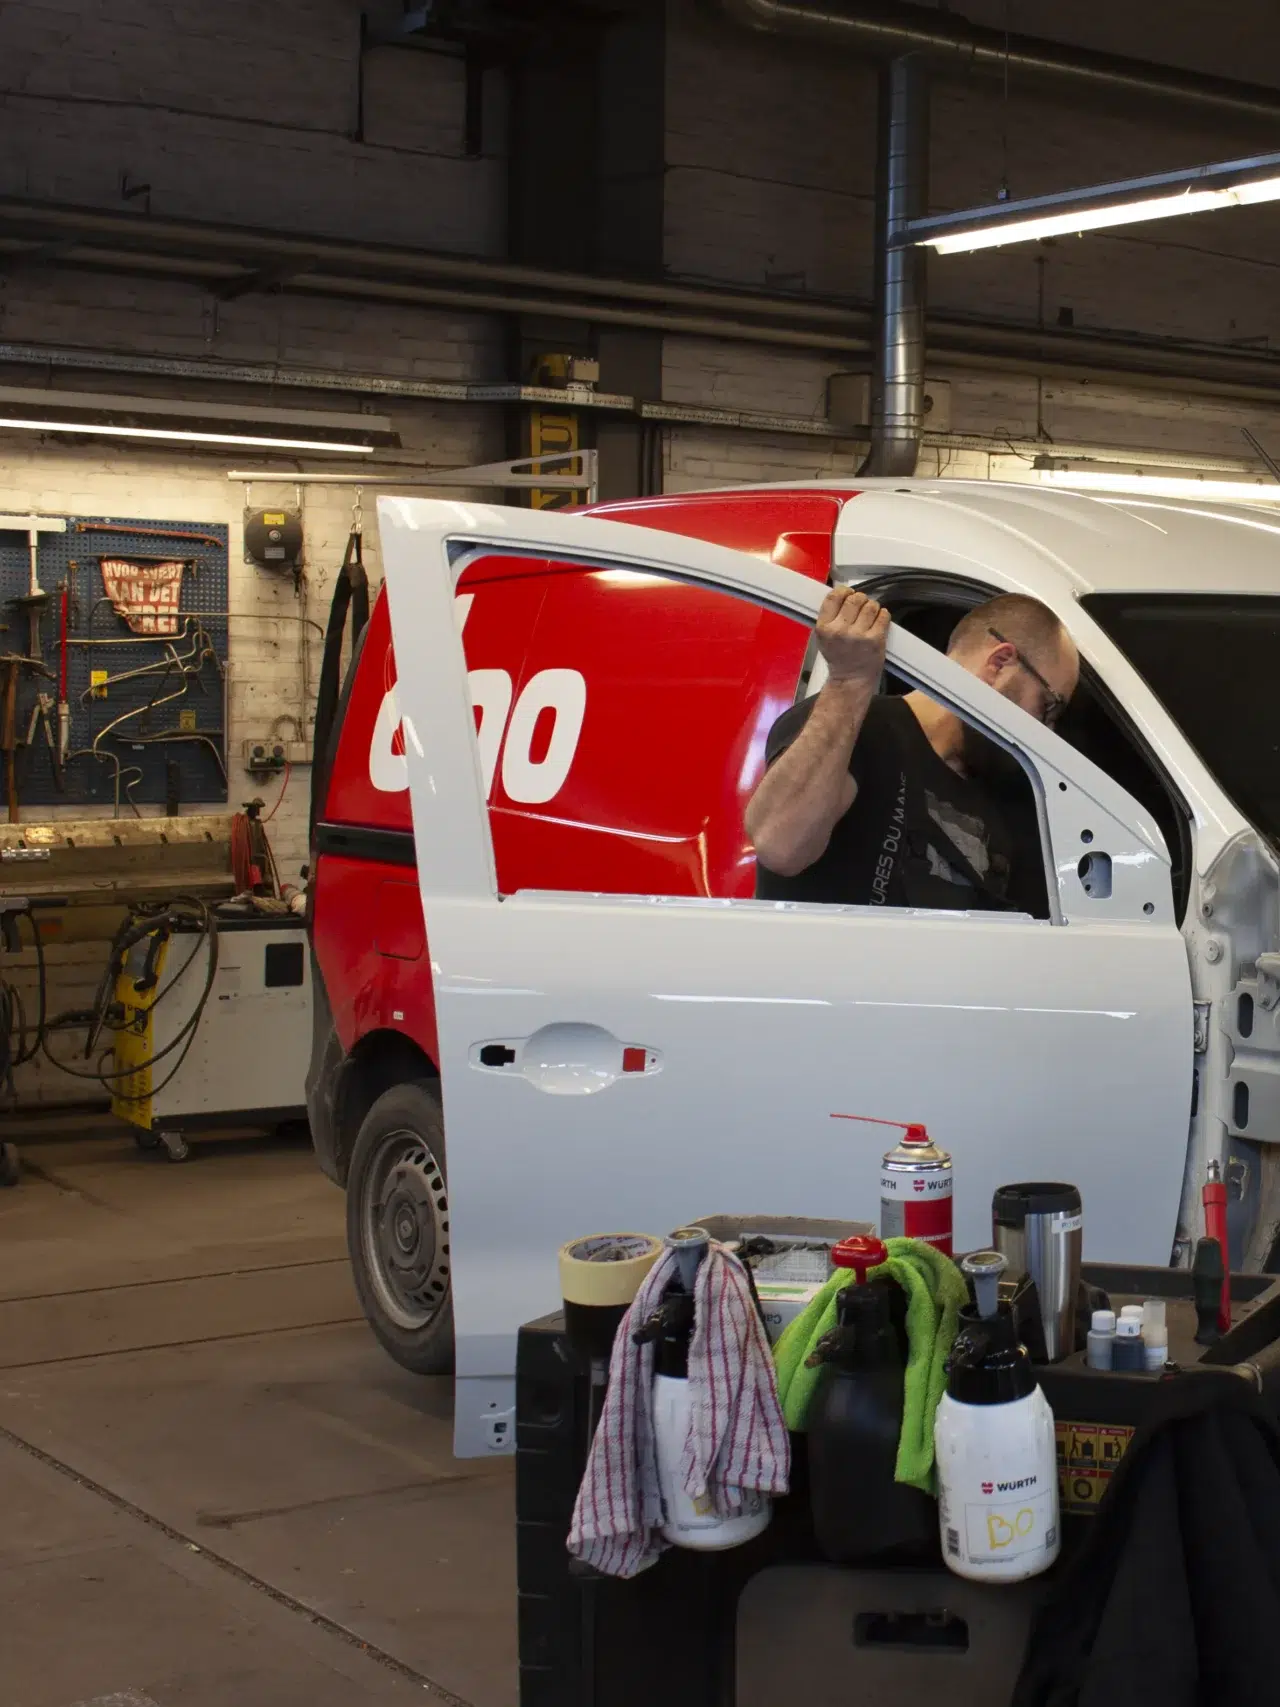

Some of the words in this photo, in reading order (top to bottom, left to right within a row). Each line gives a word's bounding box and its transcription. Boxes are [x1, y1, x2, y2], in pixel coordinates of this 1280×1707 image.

[869, 854, 894, 906] URES
[883, 825, 902, 853] DU
[997, 1476, 1037, 1492] WÜRTH
